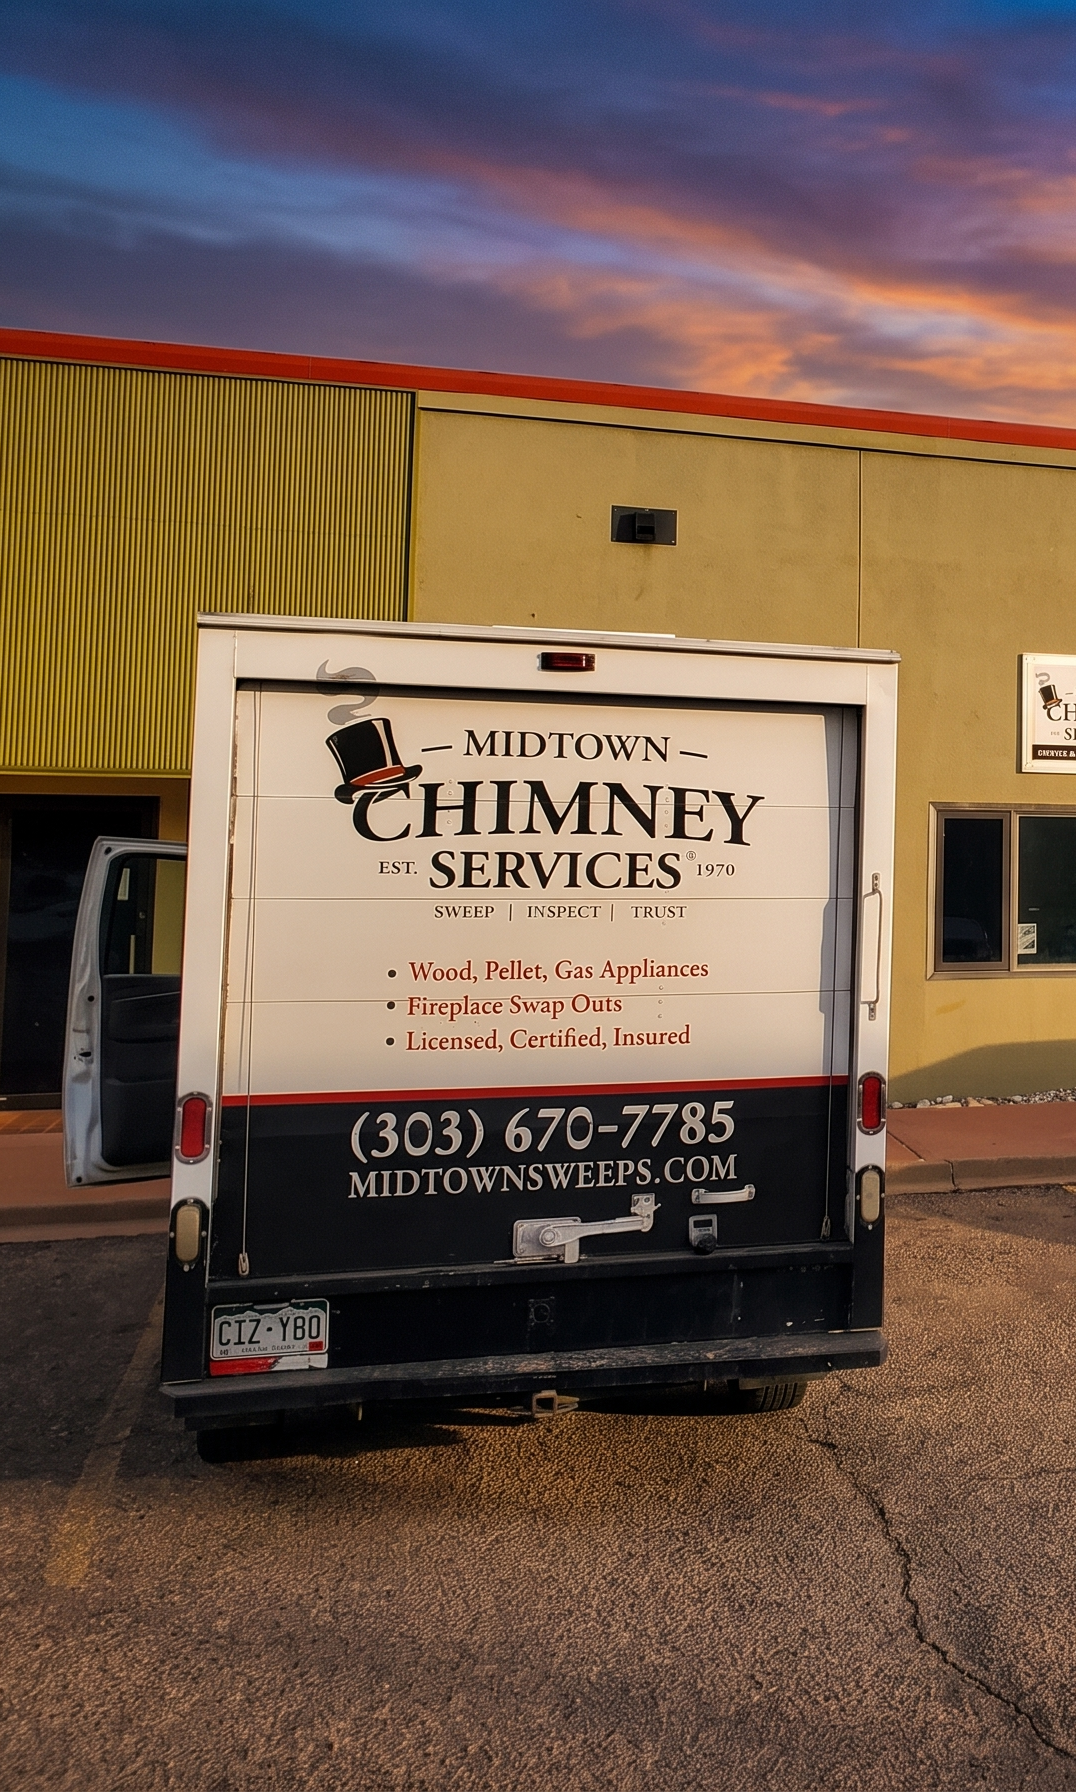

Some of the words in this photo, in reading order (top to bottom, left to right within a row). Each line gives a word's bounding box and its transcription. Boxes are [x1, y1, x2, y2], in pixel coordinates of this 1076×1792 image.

[463, 729, 671, 762] MIDTOWN
[352, 779, 765, 847] CHIMNEY
[378, 861, 418, 875] EST.
[429, 850, 682, 889] SERVICES
[696, 862, 735, 877] 1970
[434, 905, 495, 919] SWEEP
[527, 905, 601, 919] INSPECT
[631, 905, 687, 919] TRUST
[408, 961, 479, 985] Wood,
[485, 960, 548, 983] Pellet,
[555, 960, 593, 979] Gas
[600, 957, 709, 984] Appliances
[407, 995, 503, 1022] Fireplace
[509, 995, 565, 1020] Swap
[571, 993, 623, 1013] Outs
[406, 1030, 504, 1053] Licensed,
[510, 1026, 608, 1051] Certified,
[613, 1024, 691, 1048] Insured
[351, 1109, 484, 1164] (303)
[505, 1100, 735, 1153] 670-7785
[348, 1154, 738, 1199] MIDTOWNSWEEPS.COM
